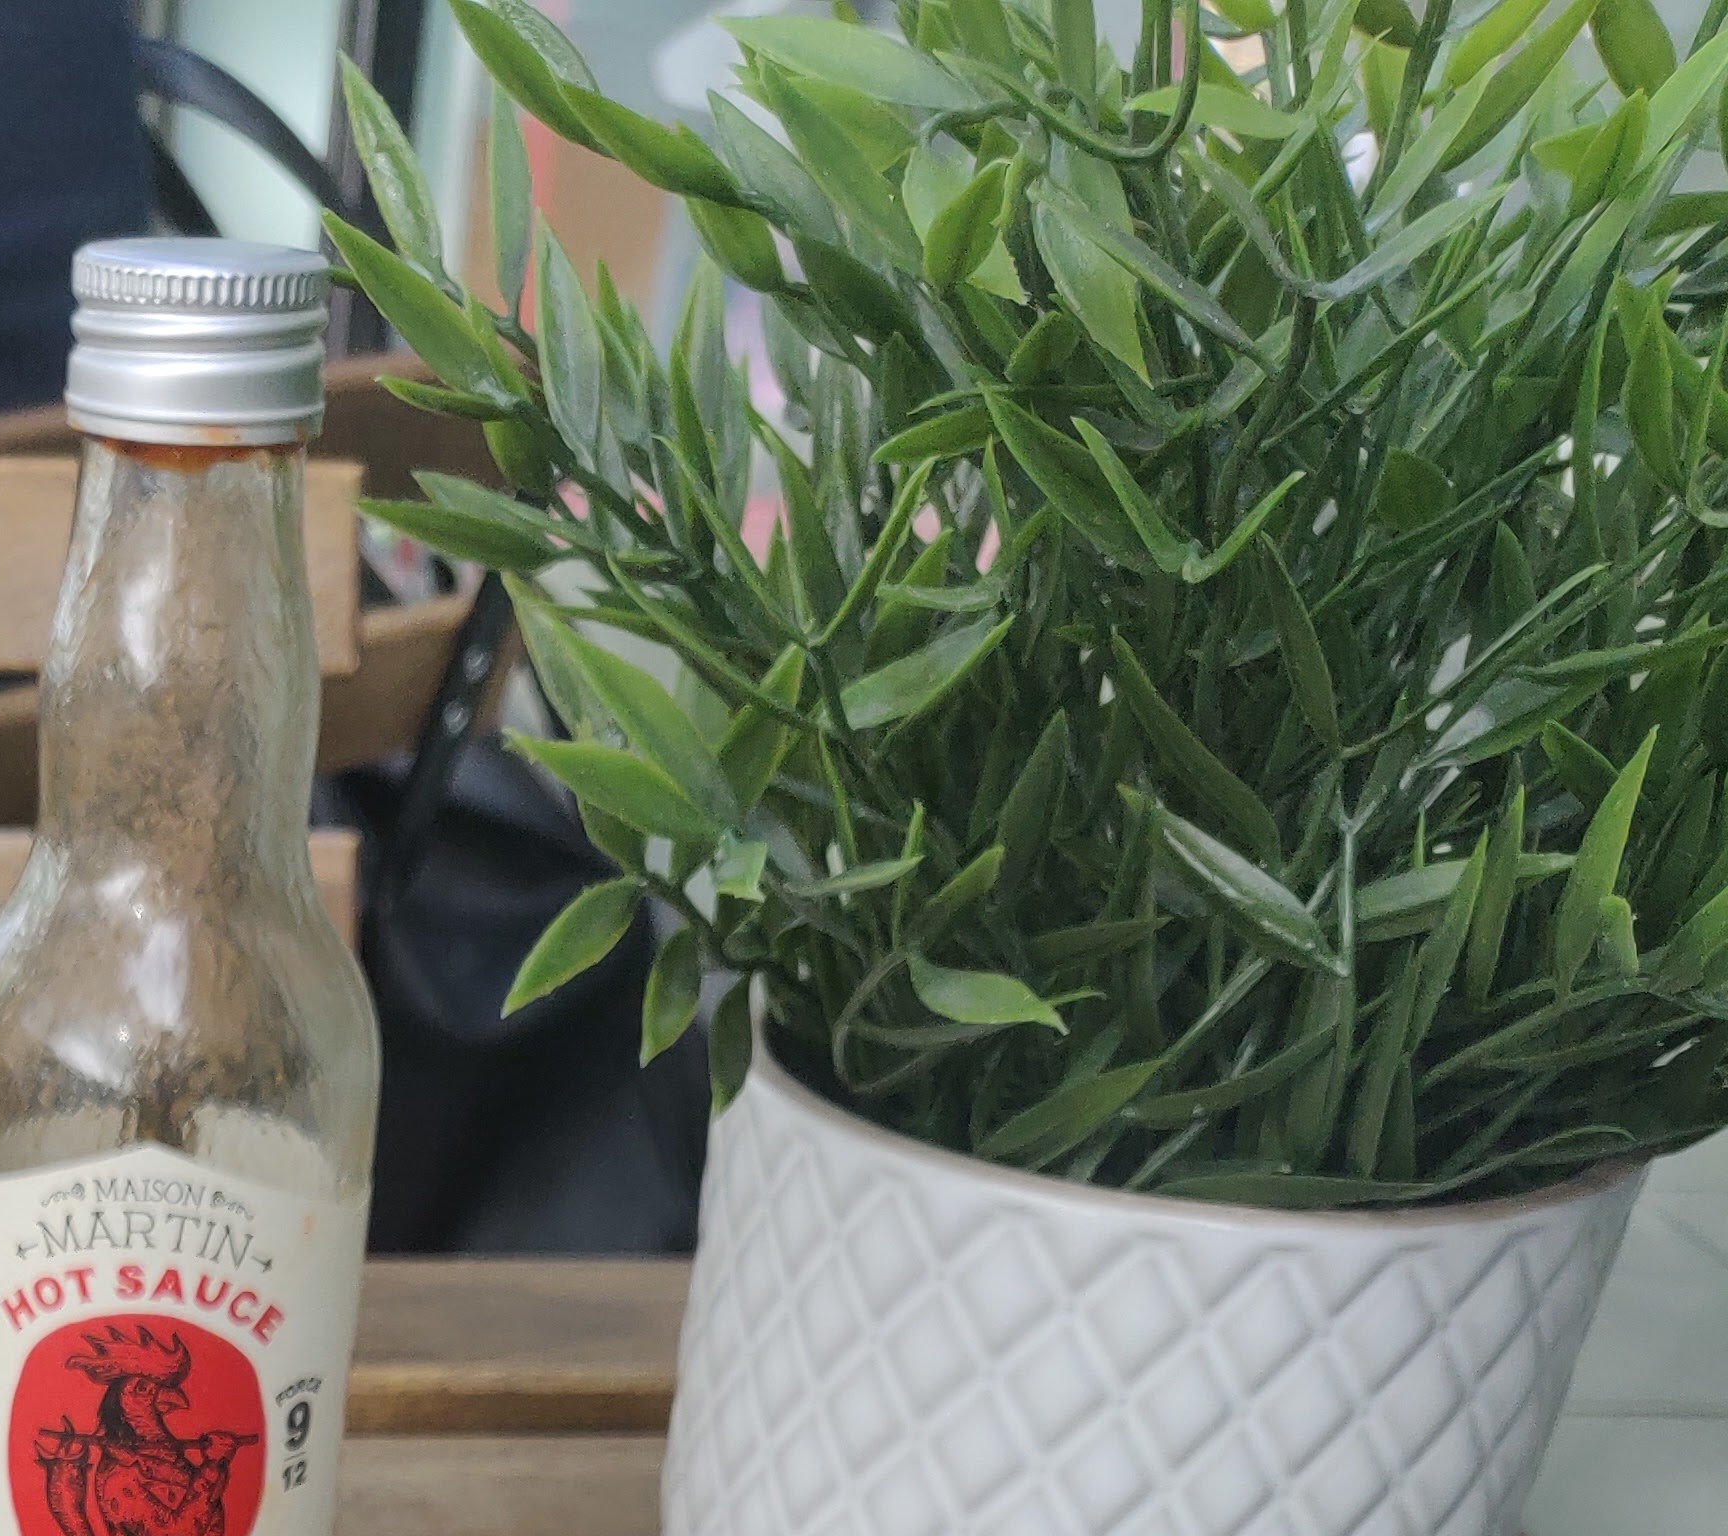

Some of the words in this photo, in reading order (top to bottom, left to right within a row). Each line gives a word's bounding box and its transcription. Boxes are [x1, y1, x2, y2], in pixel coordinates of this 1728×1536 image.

[92, 1178, 207, 1208] MAISON
[37, 1209, 255, 1272] MARTIN
[0, 1266, 95, 1333] HOT
[115, 1265, 287, 1347] SAUCE
[284, 1401, 311, 1452] 9
[282, 1459, 309, 1494] 12
